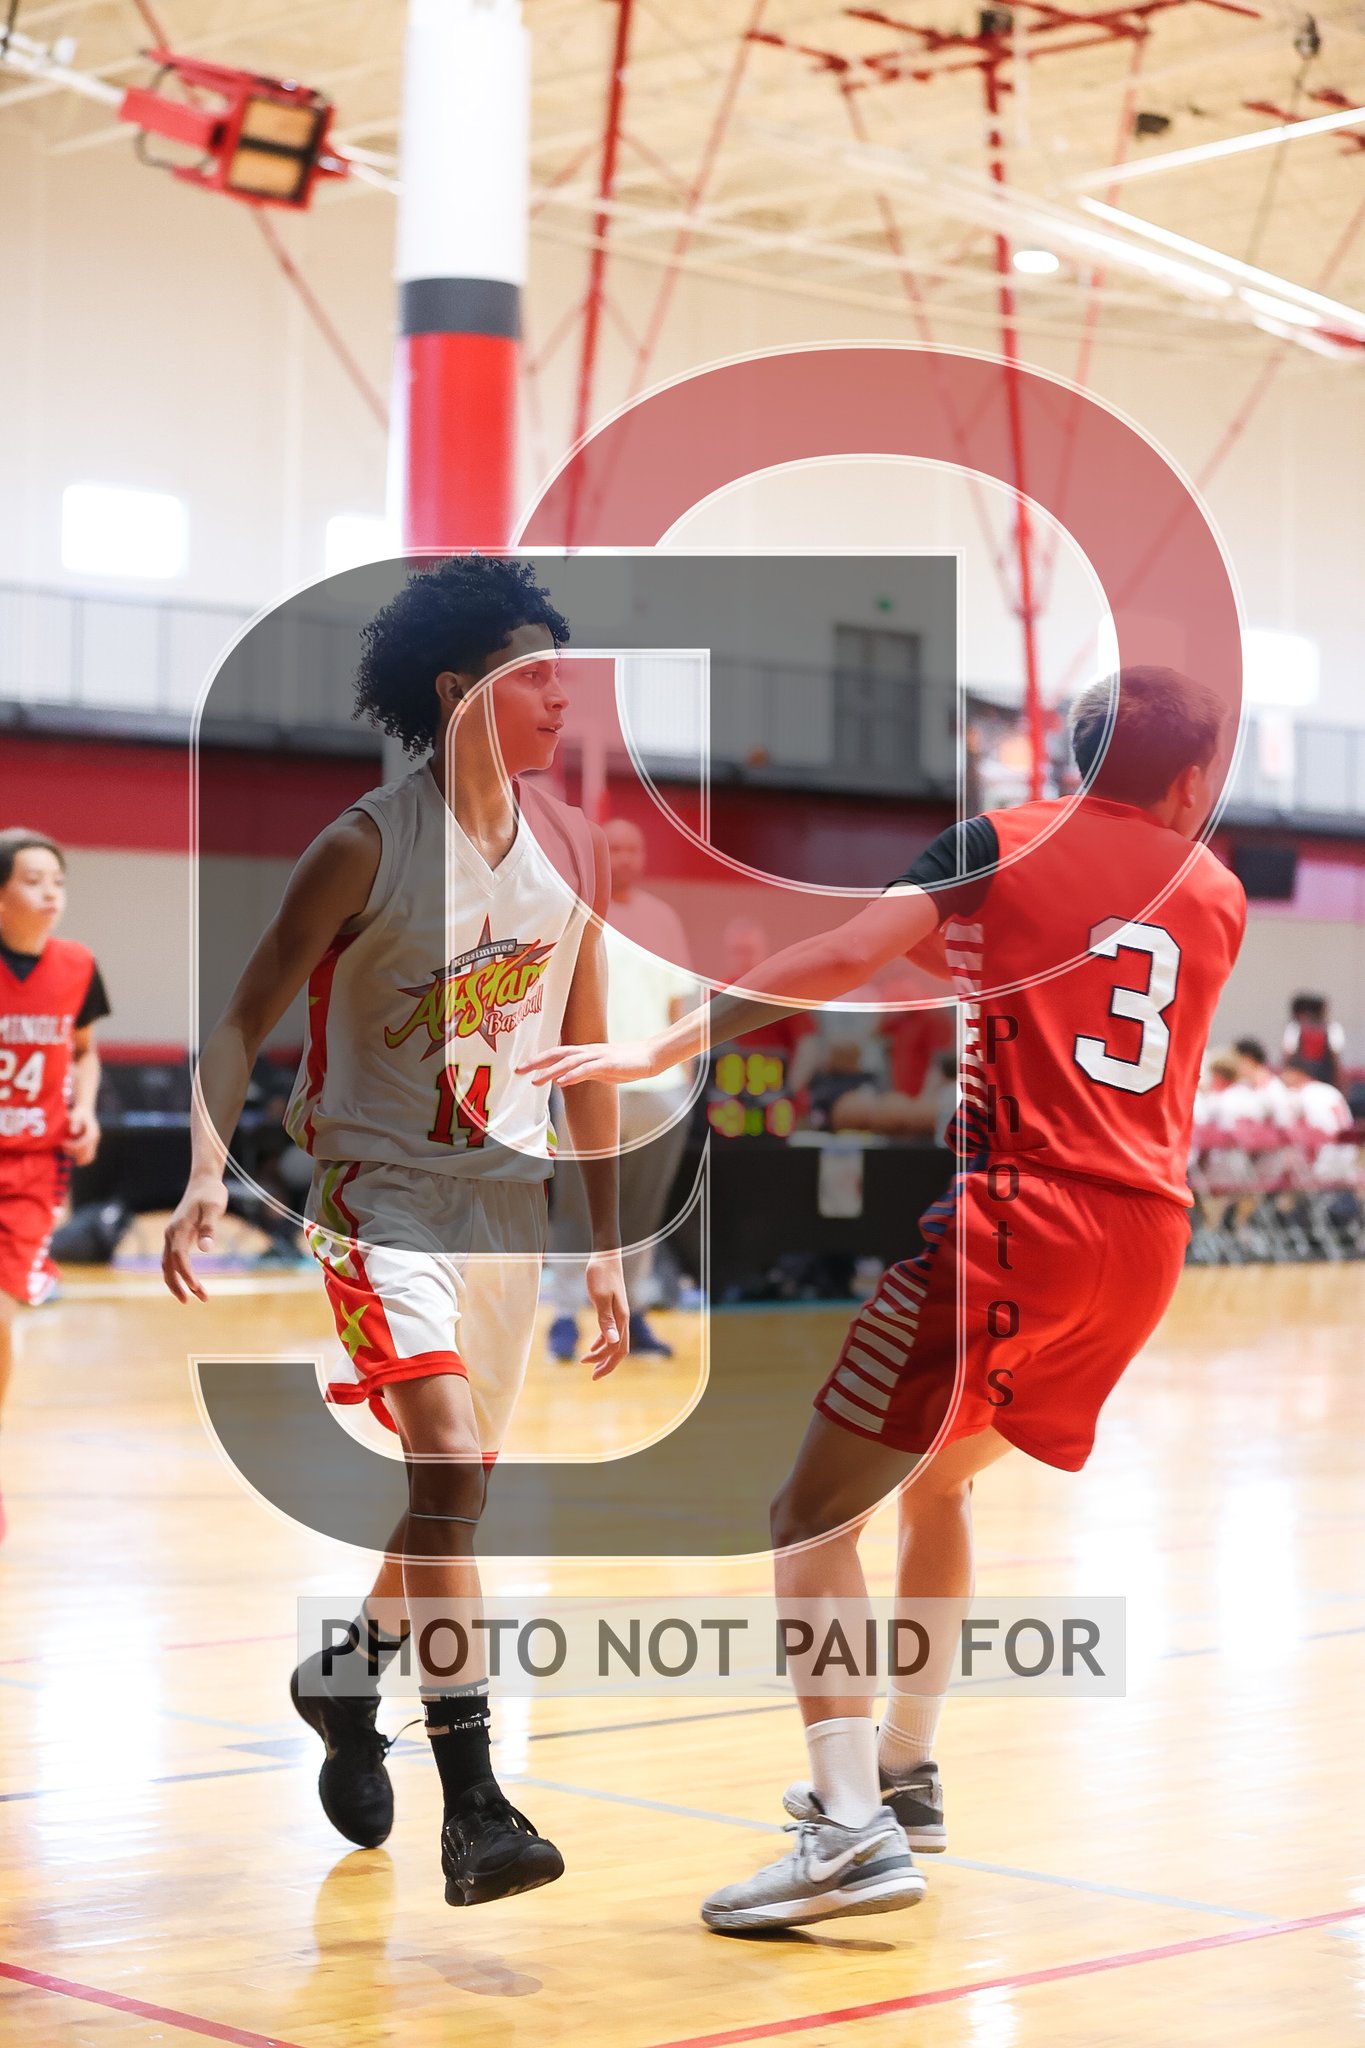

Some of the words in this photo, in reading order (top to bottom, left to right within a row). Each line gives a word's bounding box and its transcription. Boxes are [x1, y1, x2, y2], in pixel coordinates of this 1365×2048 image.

[453, 942, 514, 967] Kissimmee
[1075, 915, 1181, 1094] 3
[428, 1064, 491, 1148] 14
[453, 1719, 482, 1731] NBA
